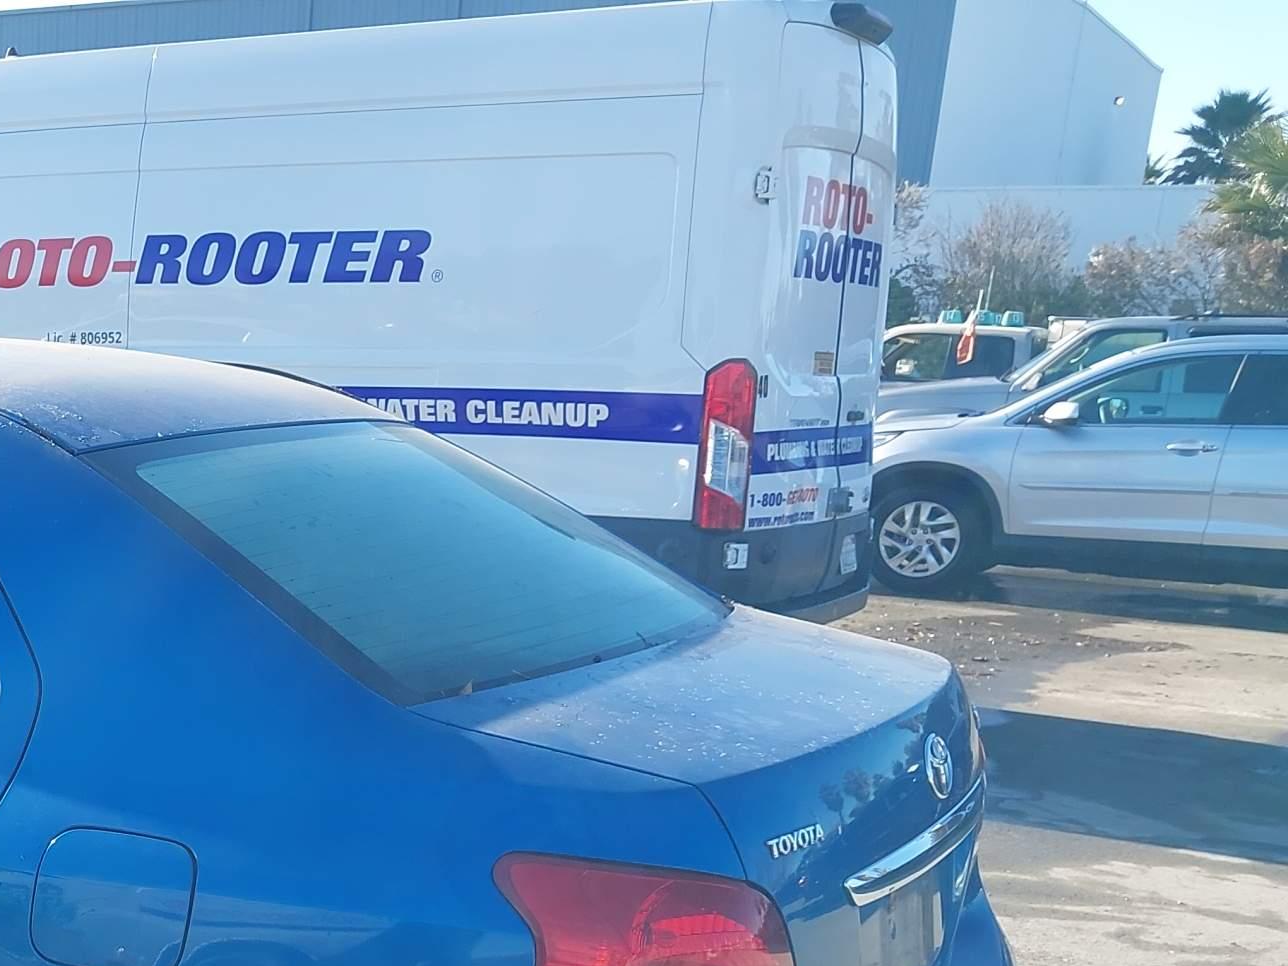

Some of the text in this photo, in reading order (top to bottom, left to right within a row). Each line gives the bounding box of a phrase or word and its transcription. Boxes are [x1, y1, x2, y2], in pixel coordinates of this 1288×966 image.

[802, 175, 873, 235] ROTO-
[793, 229, 883, 288] ROOTER
[80, 331, 122, 345] 806952
[466, 400, 610, 428] CLEANUP
[766, 823, 825, 859] TOYOTA
